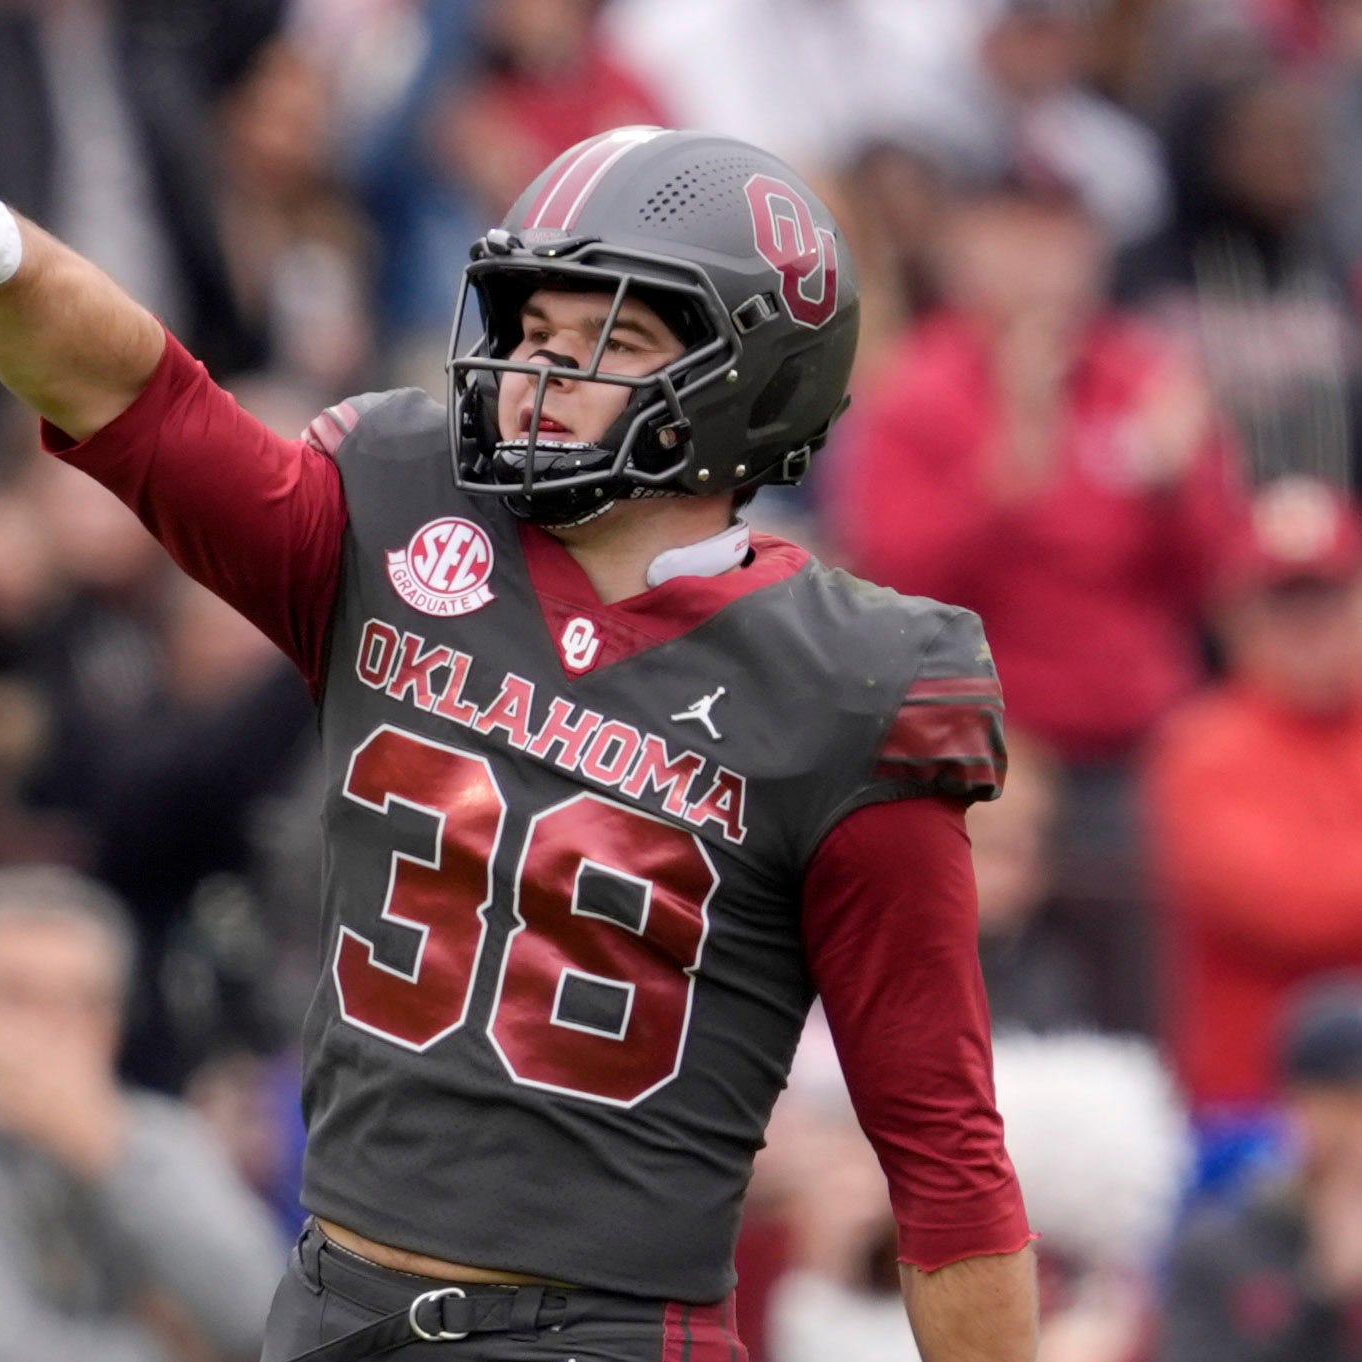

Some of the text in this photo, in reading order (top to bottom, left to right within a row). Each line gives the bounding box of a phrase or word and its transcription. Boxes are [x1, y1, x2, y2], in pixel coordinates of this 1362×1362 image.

[743, 173, 838, 330] OU
[391, 568, 473, 615] GRADUATE
[413, 522, 487, 592] SEC
[561, 617, 600, 669] OU
[356, 618, 747, 845] OKLAHOMA
[332, 723, 721, 1107] 38
